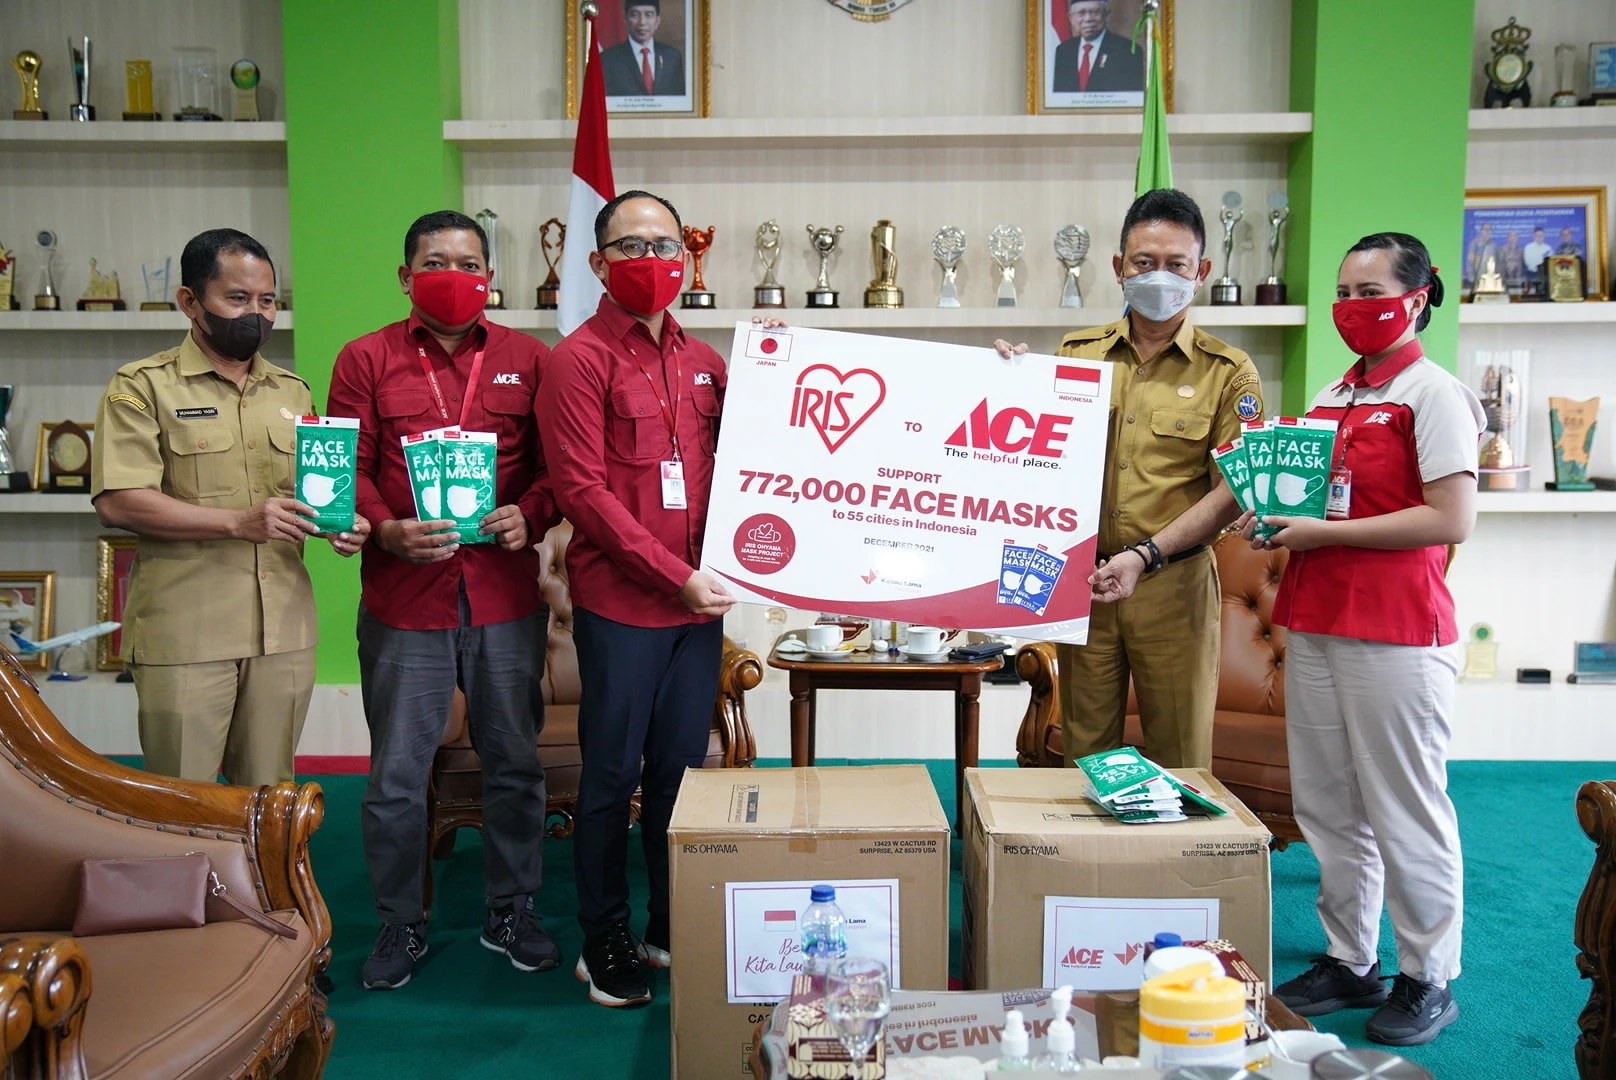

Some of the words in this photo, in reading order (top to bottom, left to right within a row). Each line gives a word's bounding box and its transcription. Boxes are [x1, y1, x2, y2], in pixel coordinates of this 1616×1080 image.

[669, 270, 680, 278] ACE
[1378, 311, 1395, 320] ACE
[492, 372, 520, 384] ACE
[694, 373, 712, 386] ACE
[1058, 395, 1093, 404] INDONESIA
[789, 386, 855, 432] IRIS
[1363, 410, 1393, 425] ACE
[904, 421, 923, 433] TO
[944, 396, 1074, 458] ACE
[301, 439, 345, 454] FACE
[1277, 439, 1321, 455] FACE
[301, 454, 351, 469] MASK
[445, 452, 486, 466] FACE
[944, 447, 969, 459] The
[973, 450, 1019, 465] helpful
[1022, 457, 1062, 470] place.
[1276, 453, 1326, 470] MASK
[445, 466, 492, 480] MASK
[877, 467, 942, 485] SUPPORT
[1332, 475, 1346, 484] ACE
[739, 469, 866, 504] 772,000
[870, 484, 958, 518] FACE
[961, 495, 1078, 533] MASKS
[832, 508, 845, 520] to
[847, 510, 864, 522] 55
[866, 512, 900, 527] cities
[902, 516, 913, 529] in
[915, 518, 977, 536] Indonesia
[757, 543, 782, 552] OHYAMA
[864, 537, 913, 549] DECEMBER
[914, 543, 935, 553] 2021
[758, 549, 784, 558] PROJECT
[1004, 549, 1028, 560] FACE
[1033, 553, 1058, 570] FACE
[1031, 560, 1059, 579] MASK
[682, 844, 698, 854] IRIS
[699, 844, 739, 854] OHYAMA
[1003, 845, 1019, 855] IRIS
[1019, 845, 1060, 856] OHYAMA
[778, 938, 801, 955] Be
[1060, 946, 1104, 965] ACE
[744, 955, 776, 974] Kita
